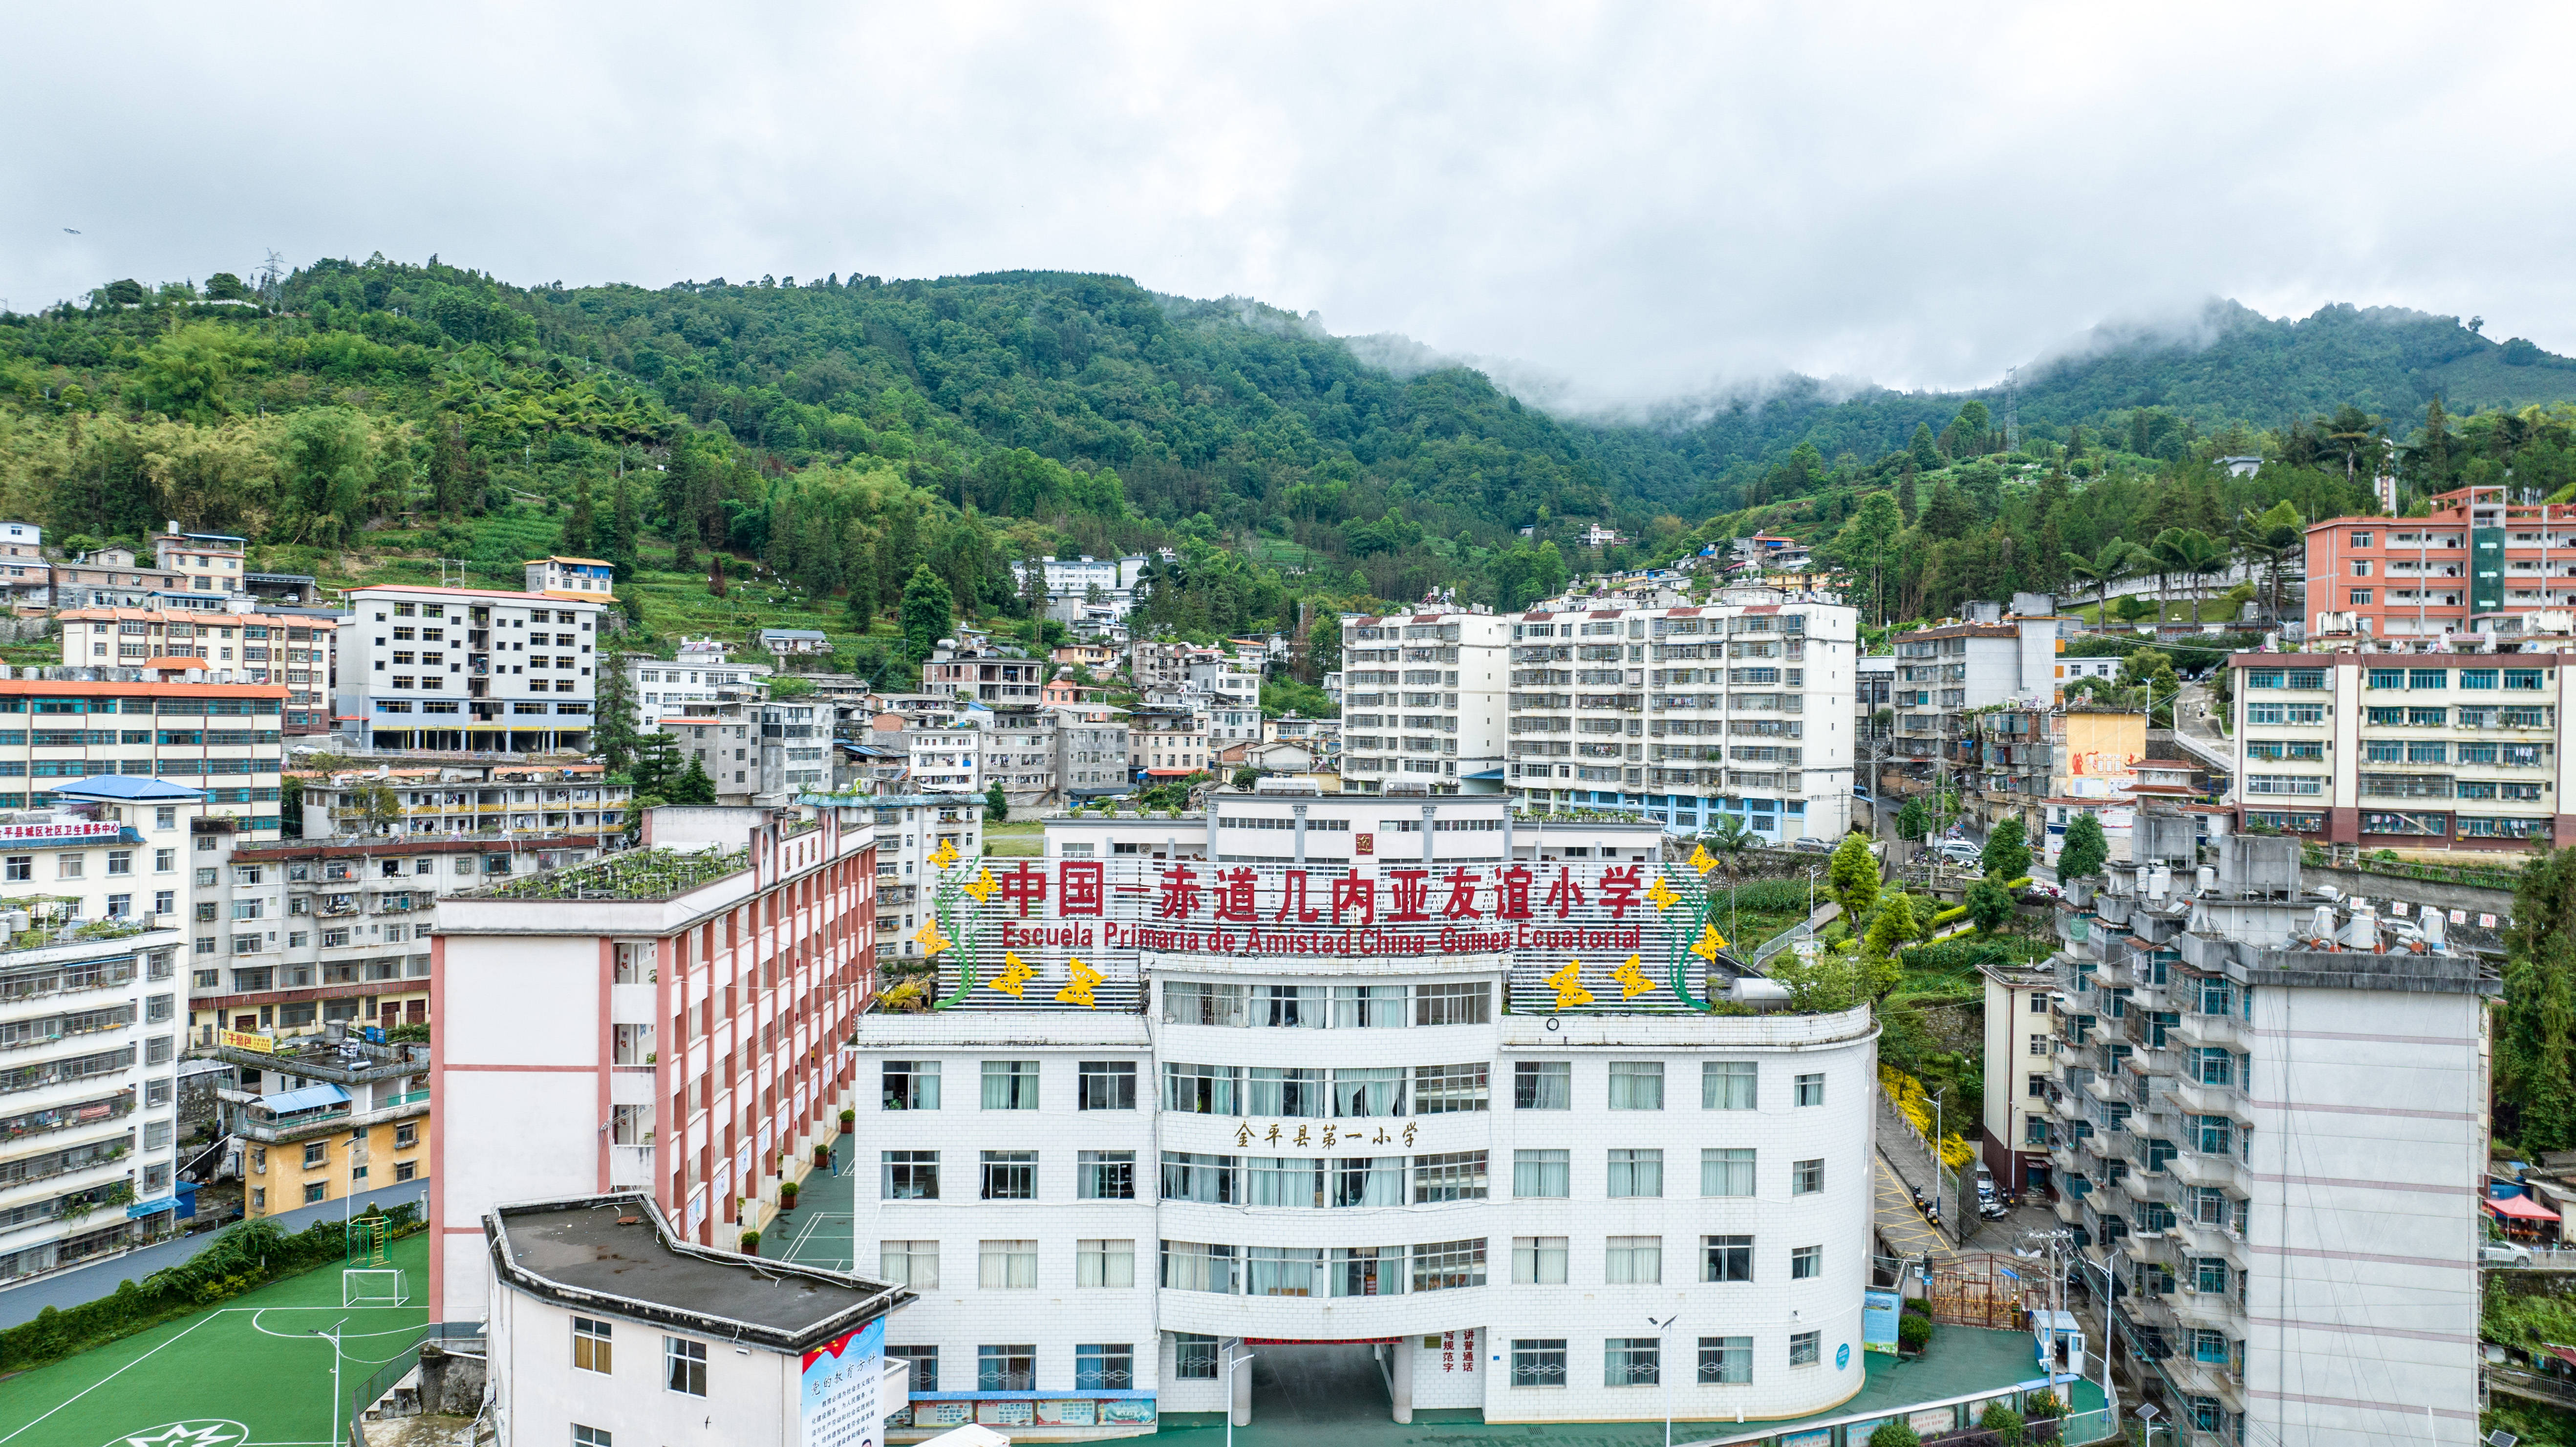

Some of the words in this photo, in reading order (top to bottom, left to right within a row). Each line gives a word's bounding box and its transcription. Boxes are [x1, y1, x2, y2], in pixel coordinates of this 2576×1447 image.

[1003, 921, 1093, 947] Escuela
[1104, 922, 1199, 951] Primaria
[1207, 926, 1236, 952] de
[1245, 927, 1351, 954] Amistad
[1517, 924, 1640, 949] Ecuatorial
[1234, 1120, 1418, 1150] 金平县第一小学
[1443, 1331, 1455, 1373] 写规范字
[1463, 1330, 1475, 1372] 讲普通话
[811, 1352, 876, 1397] 党的教育方针
